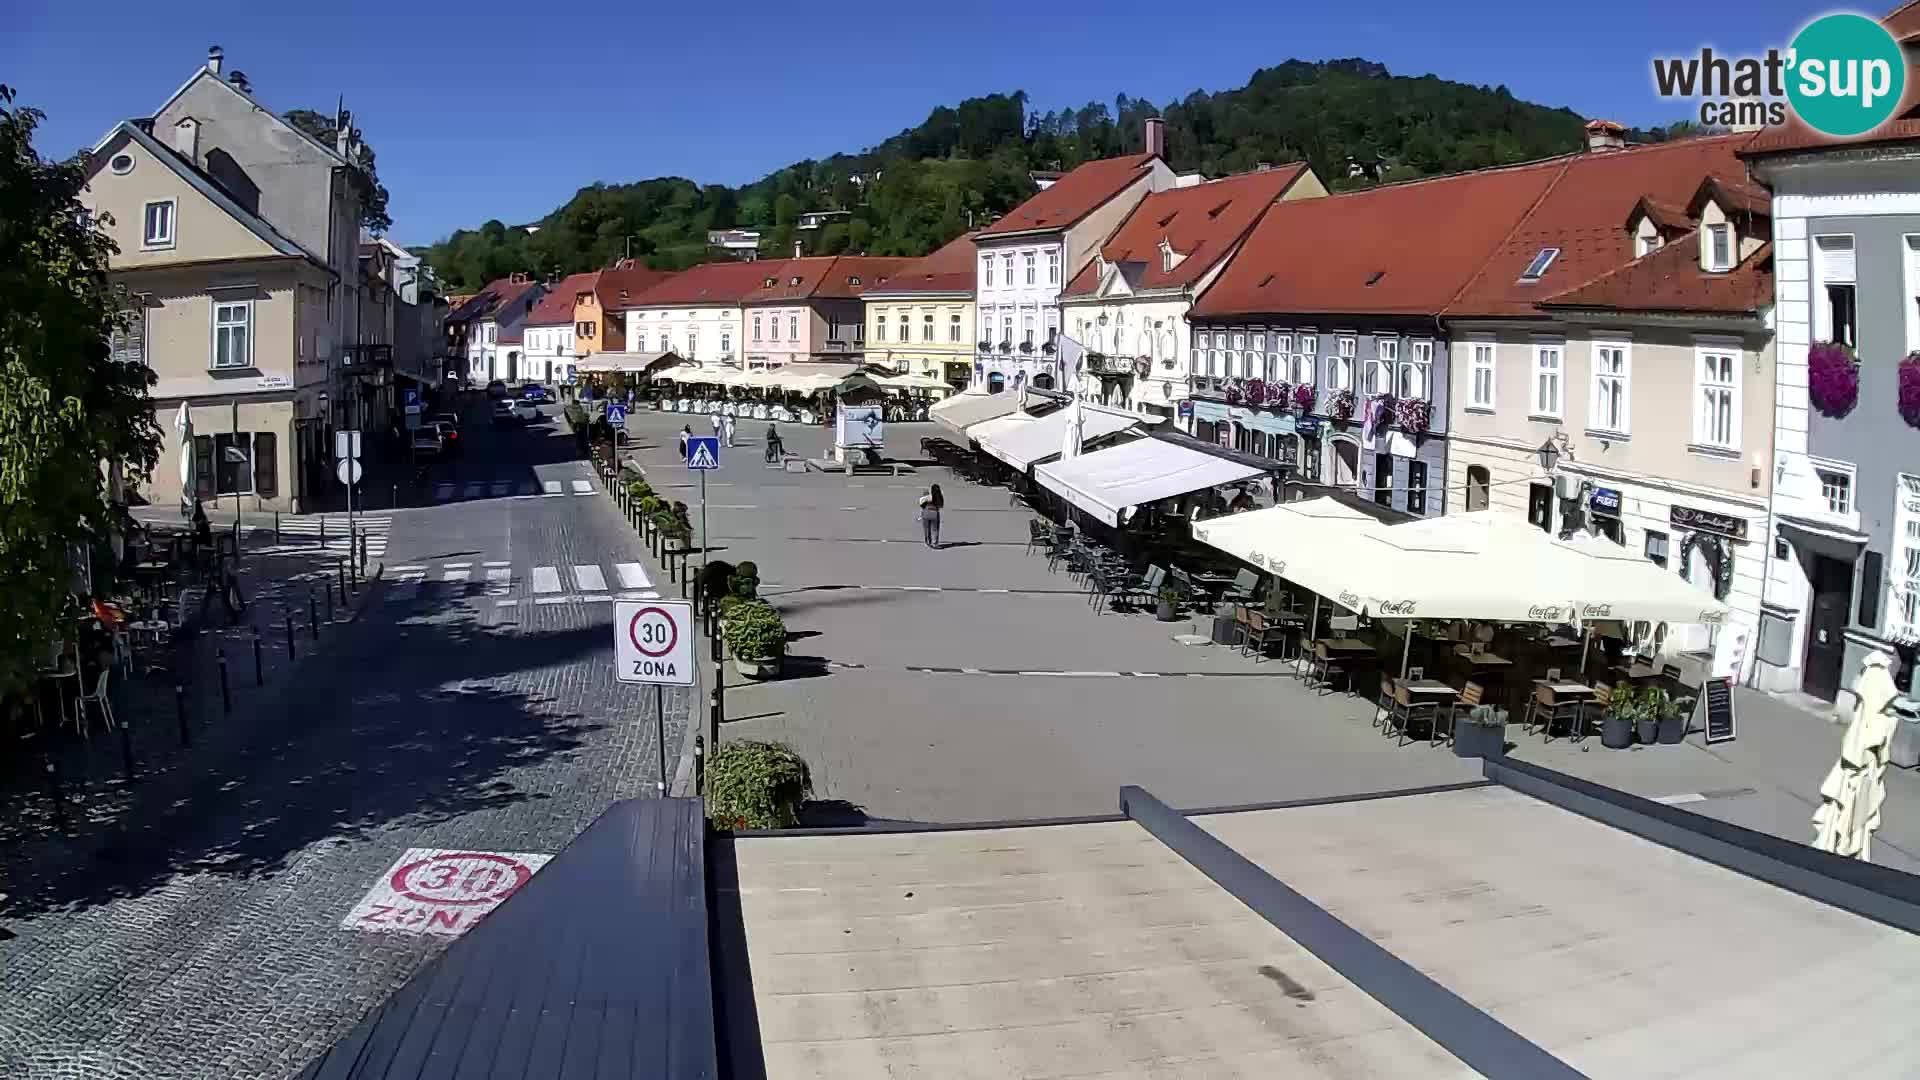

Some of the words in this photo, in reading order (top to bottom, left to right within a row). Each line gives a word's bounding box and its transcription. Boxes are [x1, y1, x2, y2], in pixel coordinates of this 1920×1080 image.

[642, 623, 666, 644] 30
[633, 660, 676, 677] ZONA
[419, 865, 504, 893] 30
